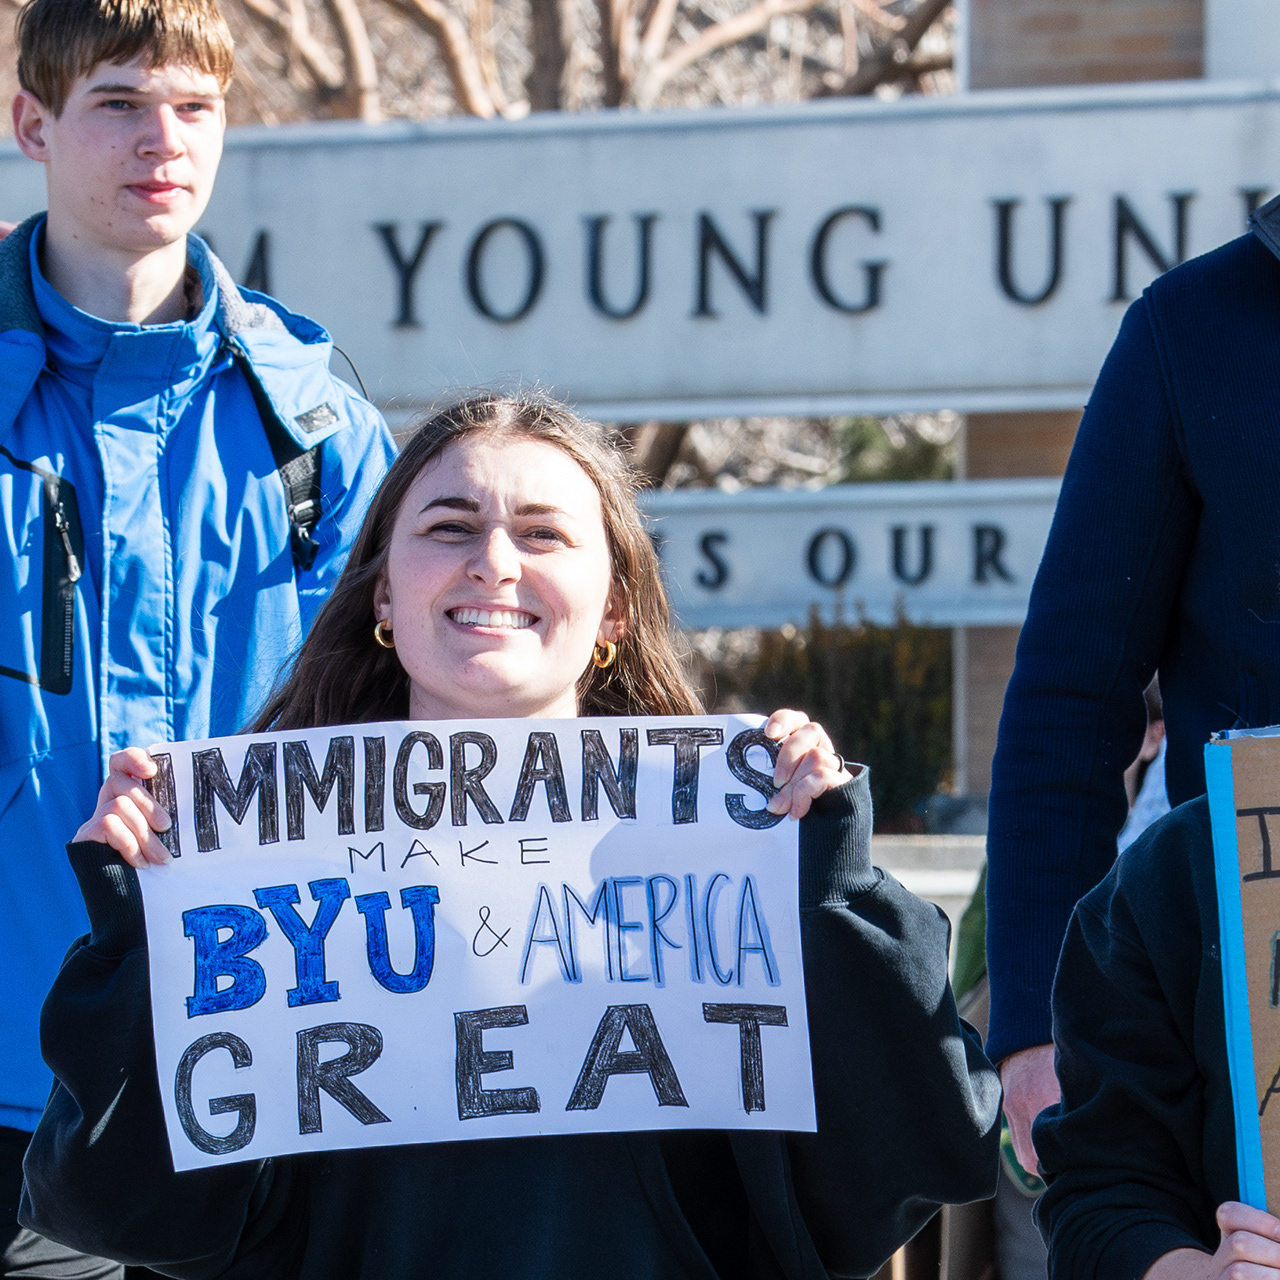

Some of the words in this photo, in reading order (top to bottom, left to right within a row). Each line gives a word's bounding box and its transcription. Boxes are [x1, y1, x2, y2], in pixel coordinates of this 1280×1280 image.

[370, 206, 893, 330] YOUNG
[805, 522, 1017, 588] OUR
[142, 727, 787, 858] IMMIGRANTS
[348, 837, 551, 874] MAKE
[182, 877, 440, 1018] BYU
[472, 906, 512, 957] &
[518, 872, 781, 988] AMERICA
[173, 1003, 789, 1155] GREAT
